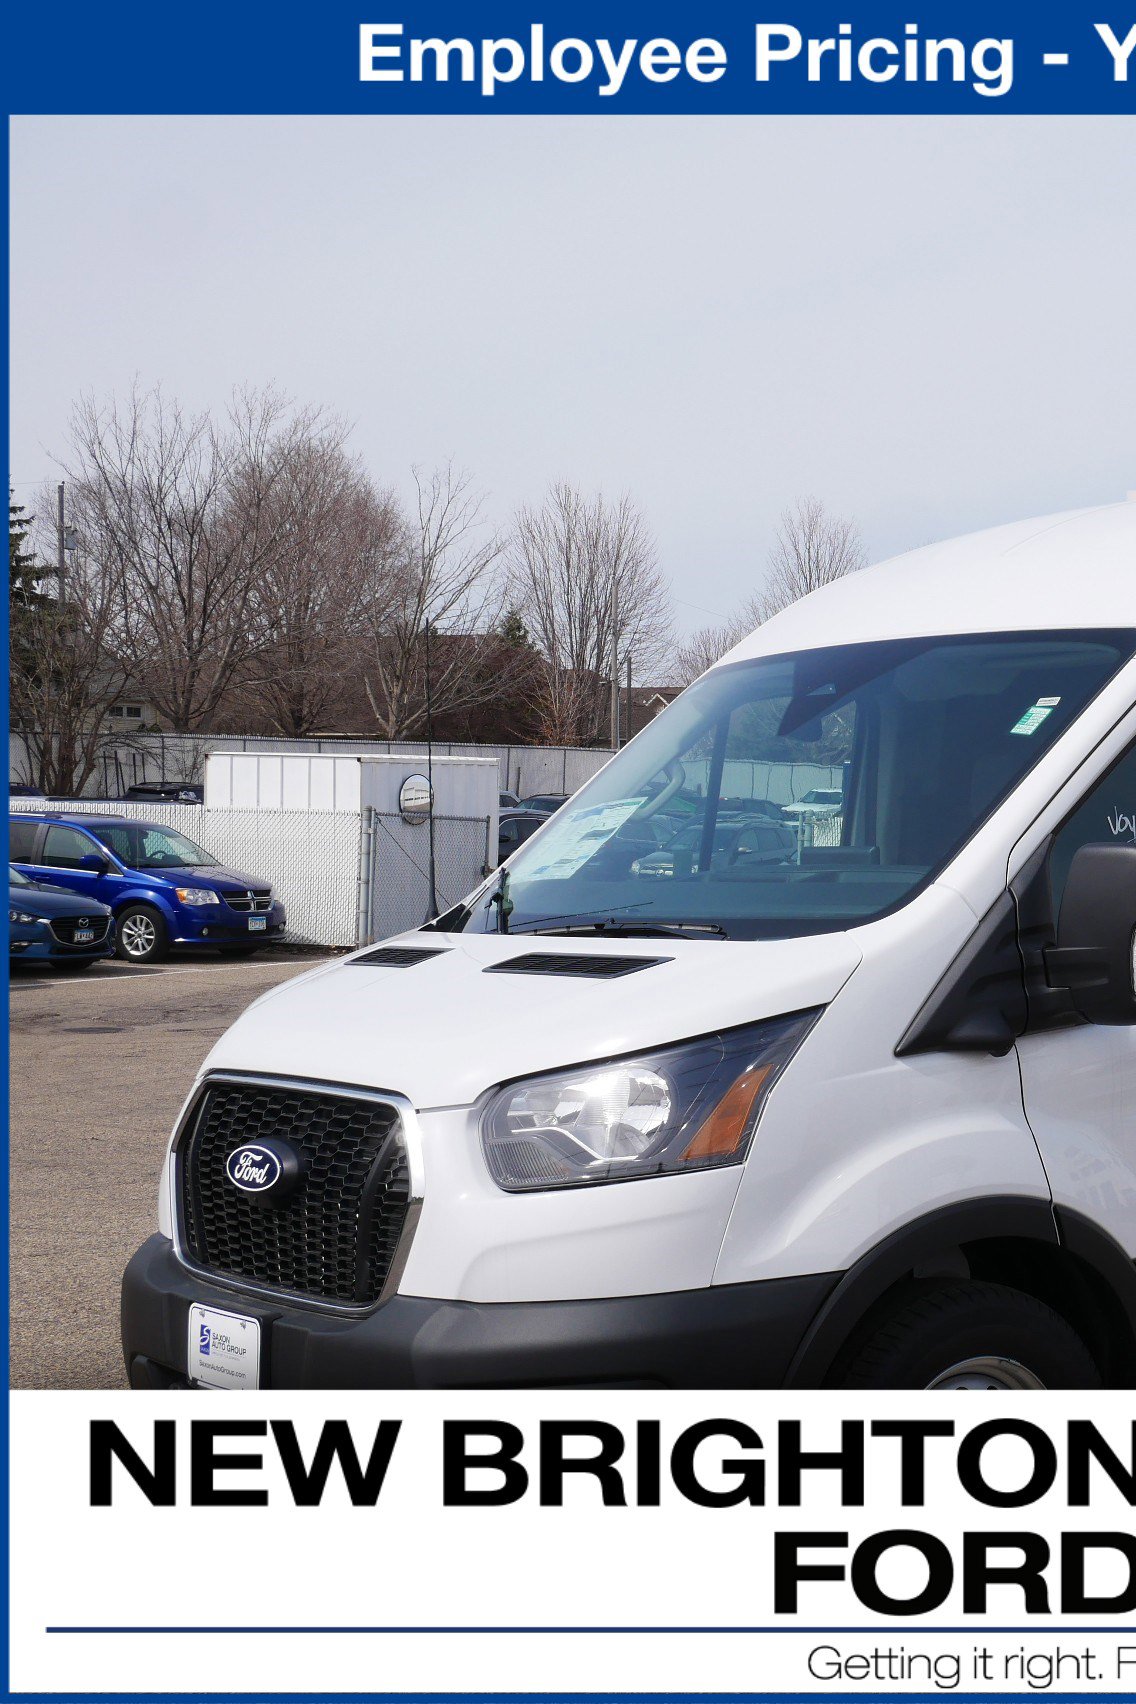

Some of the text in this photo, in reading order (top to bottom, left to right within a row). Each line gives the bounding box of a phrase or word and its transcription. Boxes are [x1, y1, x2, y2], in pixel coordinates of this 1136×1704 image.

[234, 1151, 270, 1184] Ford
[212, 1333, 231, 1344] SAXON
[212, 1341, 226, 1351] AUTO
[227, 1344, 247, 1356] GROUP
